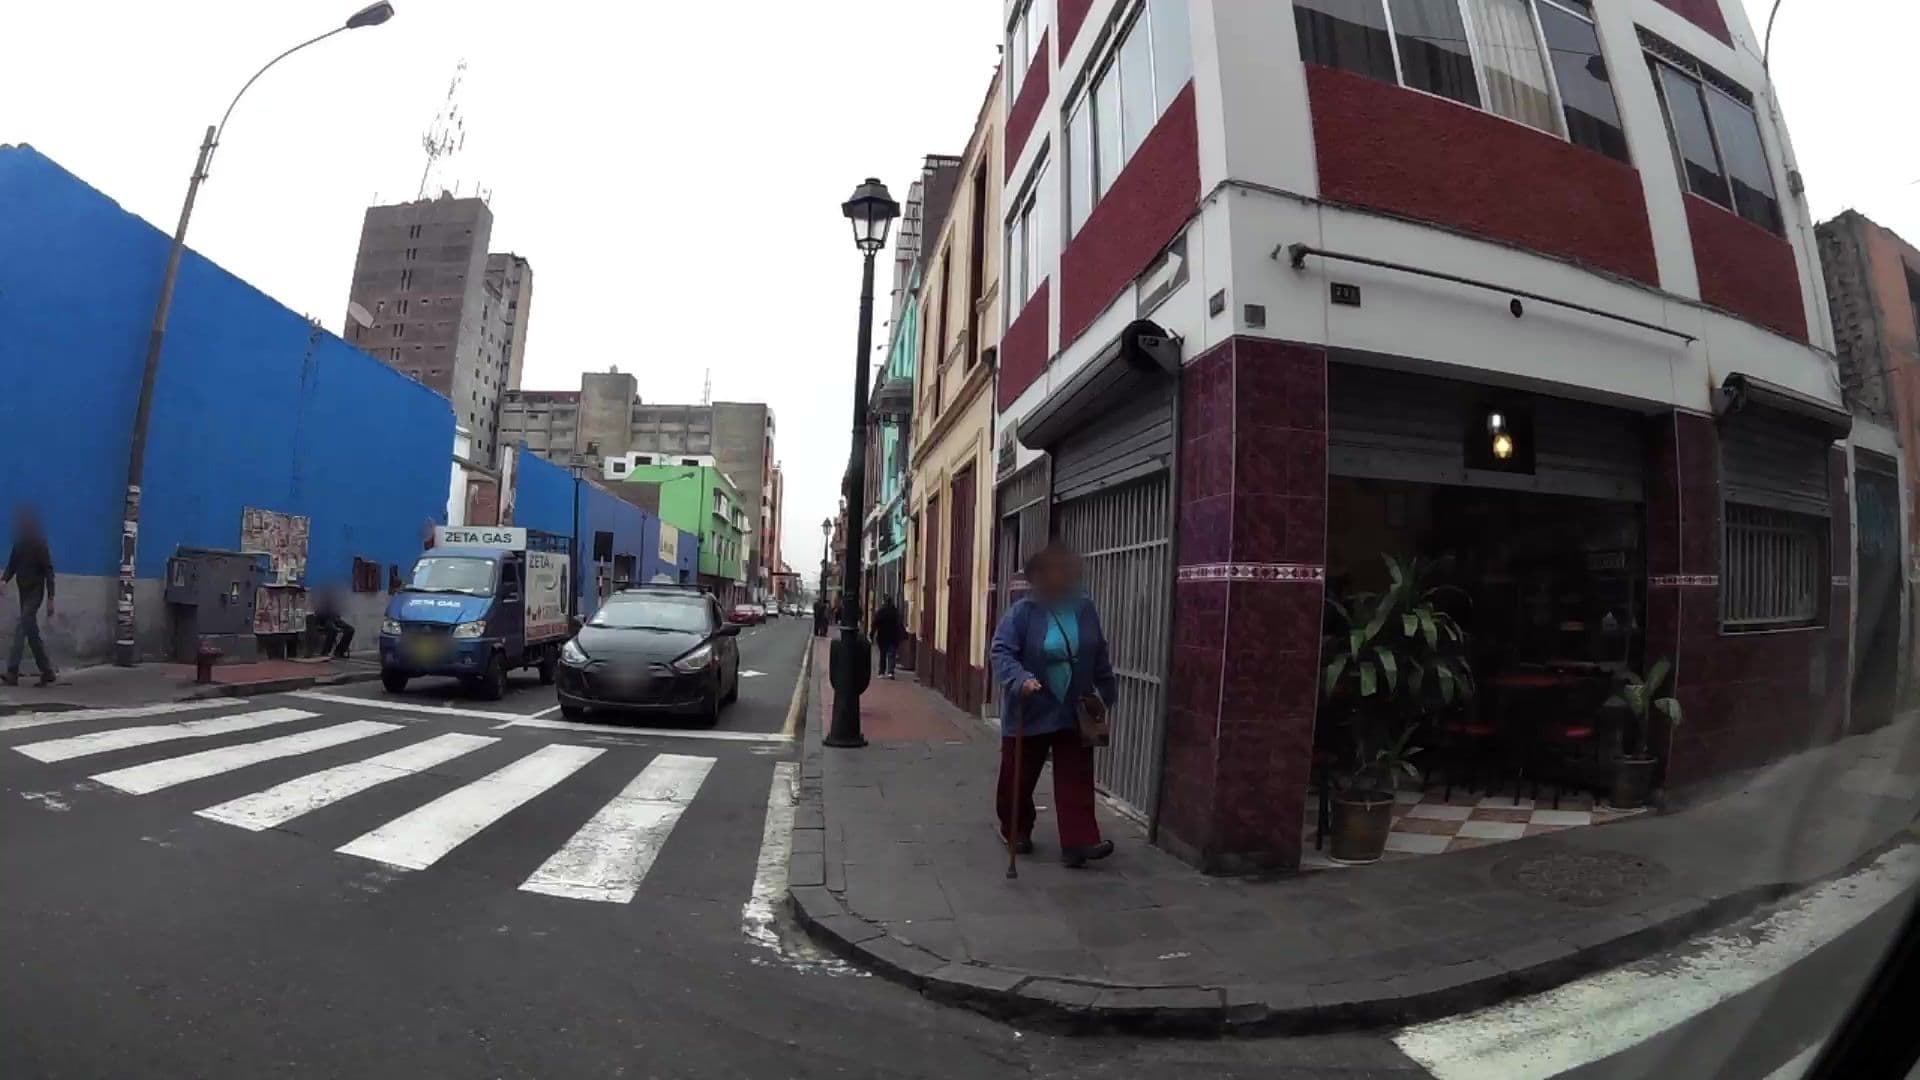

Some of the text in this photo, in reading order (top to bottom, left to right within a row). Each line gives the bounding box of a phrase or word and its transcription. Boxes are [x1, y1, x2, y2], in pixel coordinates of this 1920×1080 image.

[445, 531, 512, 543] ZETA GAS
[528, 554, 551, 569] ZETA
